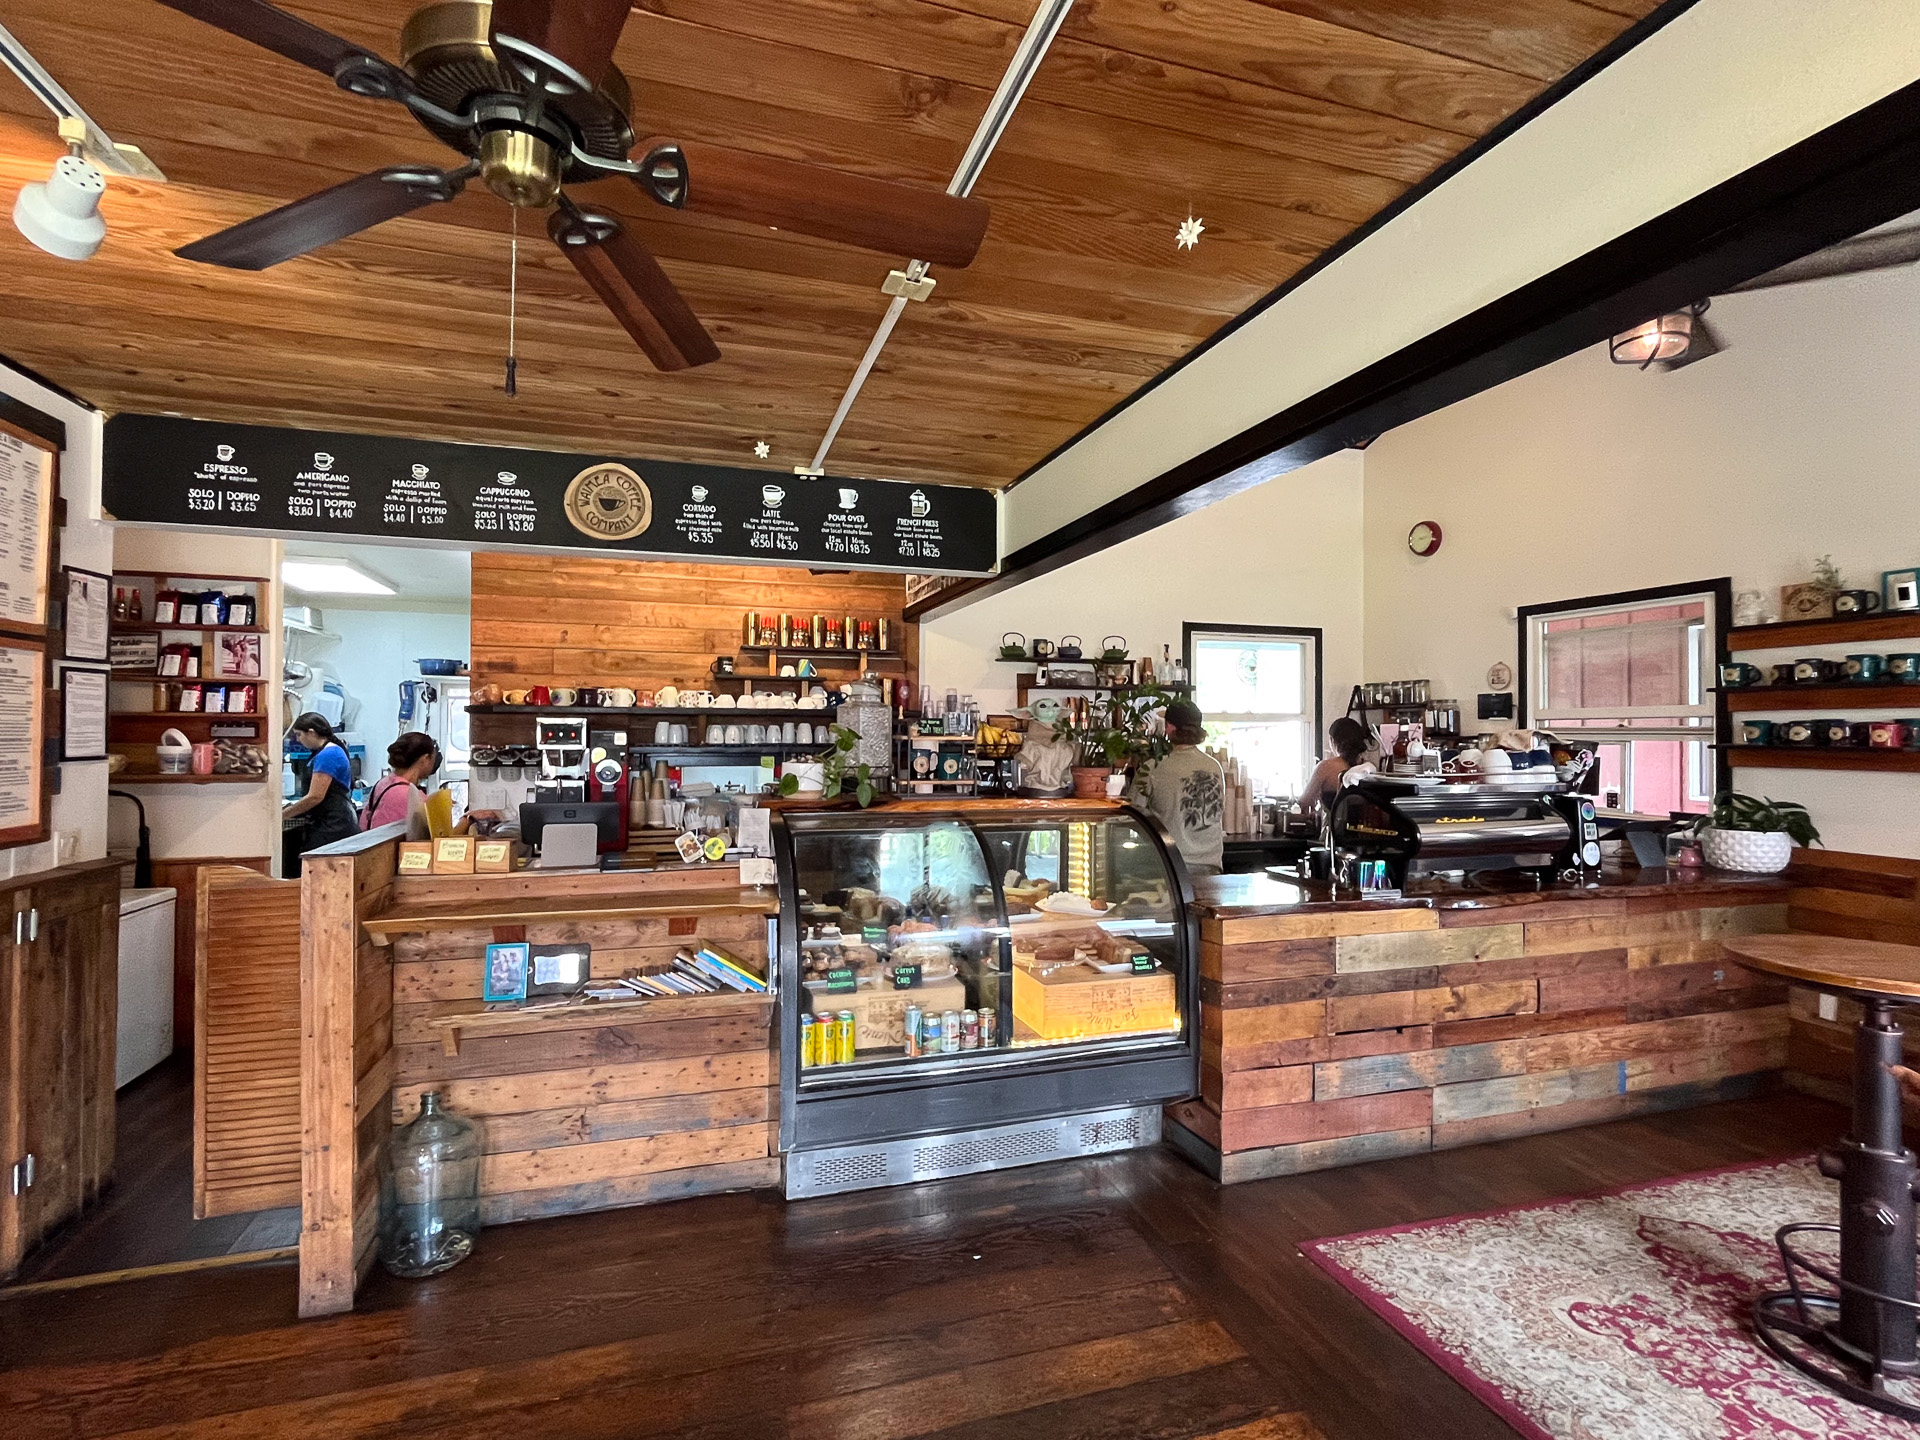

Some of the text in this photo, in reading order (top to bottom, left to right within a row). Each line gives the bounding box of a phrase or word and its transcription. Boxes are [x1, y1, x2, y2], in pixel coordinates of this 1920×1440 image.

[204, 463, 248, 474] ESPRESSO
[296, 472, 349, 482] AMERICANO
[392, 480, 440, 489] MACCHIATO
[188, 488, 260, 501] SOLO DOPPIO
[480, 487, 530, 497] CAPPUCCINO
[578, 474, 642, 511] WAIMEA COFFEE
[230, 501, 256, 512] $3.65
[288, 496, 356, 508] SOLO DOPPIO
[288, 506, 352, 518] $3.80 $4.40
[383, 504, 447, 514] SOLO DOPPIO
[683, 504, 716, 512] CORTADO
[383, 513, 444, 524] $4.40 $5.00
[507, 513, 535, 521] DOPPIO
[763, 510, 781, 518] LATTE
[509, 520, 534, 531] $5.80
[587, 511, 635, 531] COMPANY
[688, 531, 714, 543] $5.35
